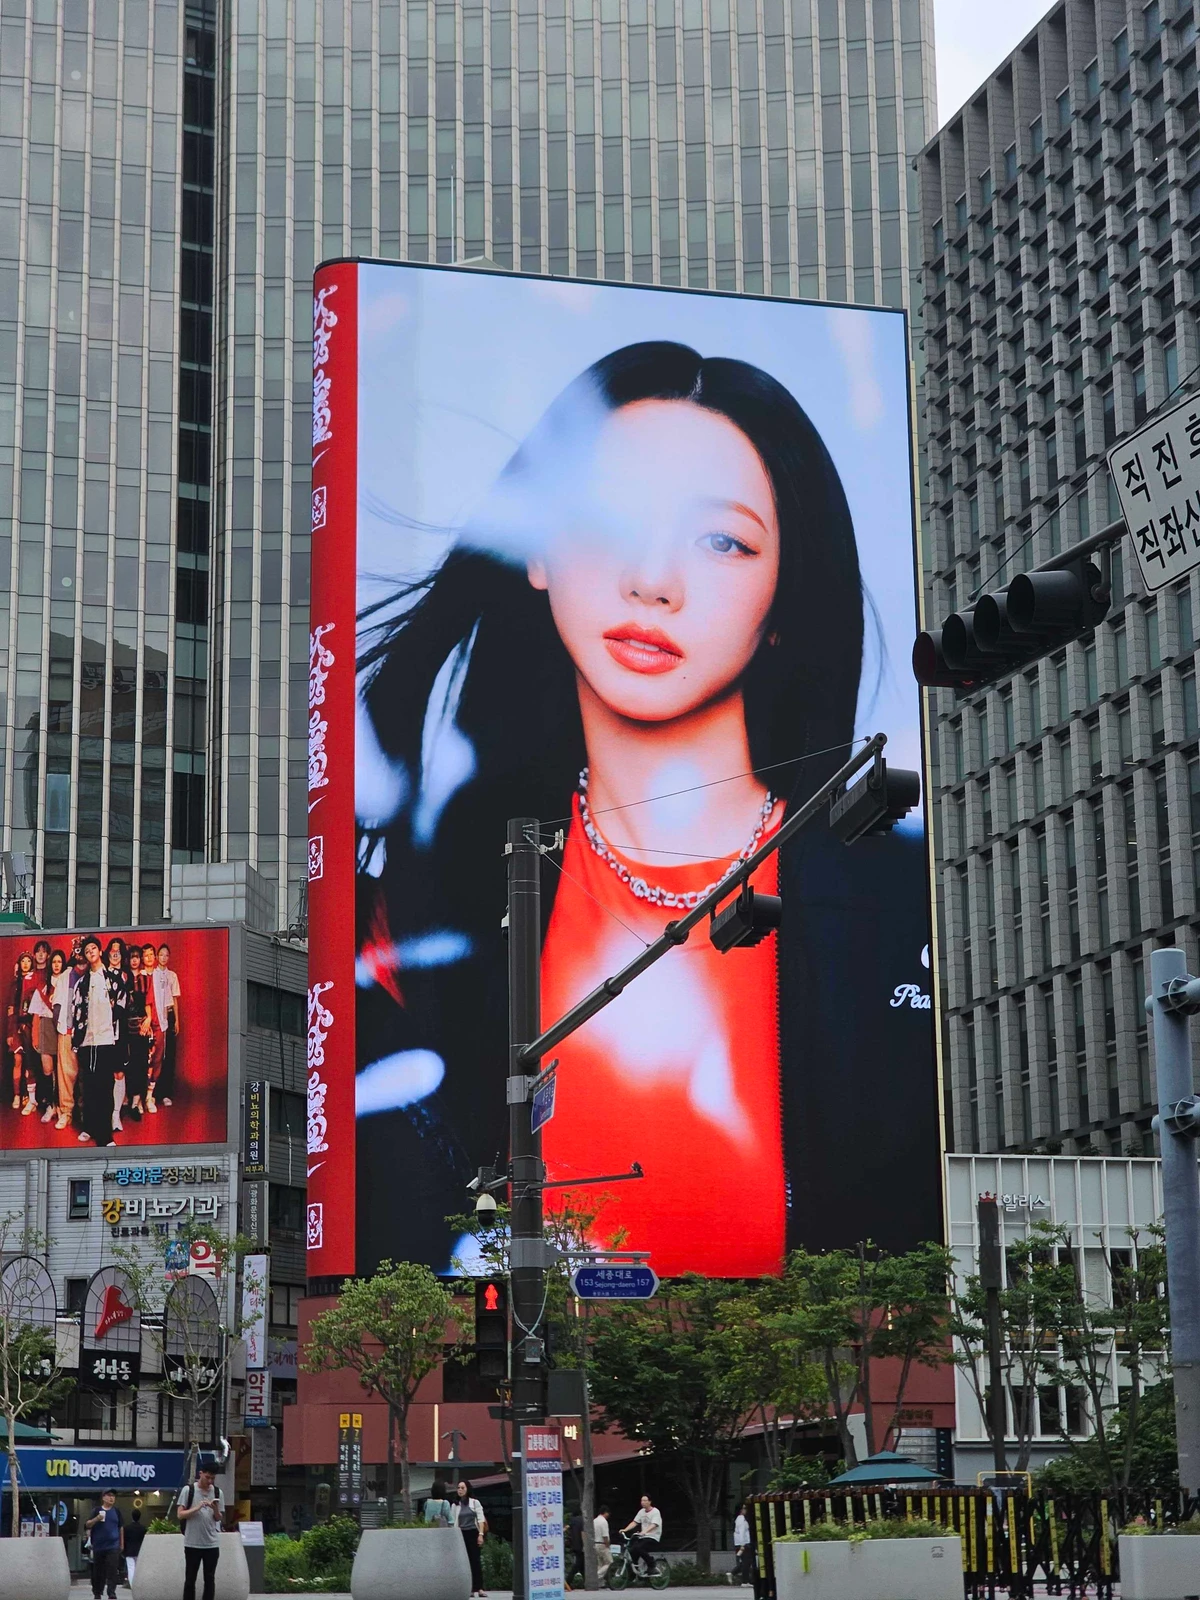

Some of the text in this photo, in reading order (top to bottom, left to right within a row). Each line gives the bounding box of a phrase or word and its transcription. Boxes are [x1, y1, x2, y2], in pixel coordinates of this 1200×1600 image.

[1002, 1193, 1046, 1212] 할리스
[580, 1278, 650, 1289] 153 Sejong-daero 157
[596, 1270, 633, 1280] 세종대로
[93, 1358, 132, 1381] 청담동
[248, 1373, 265, 1417] 약국
